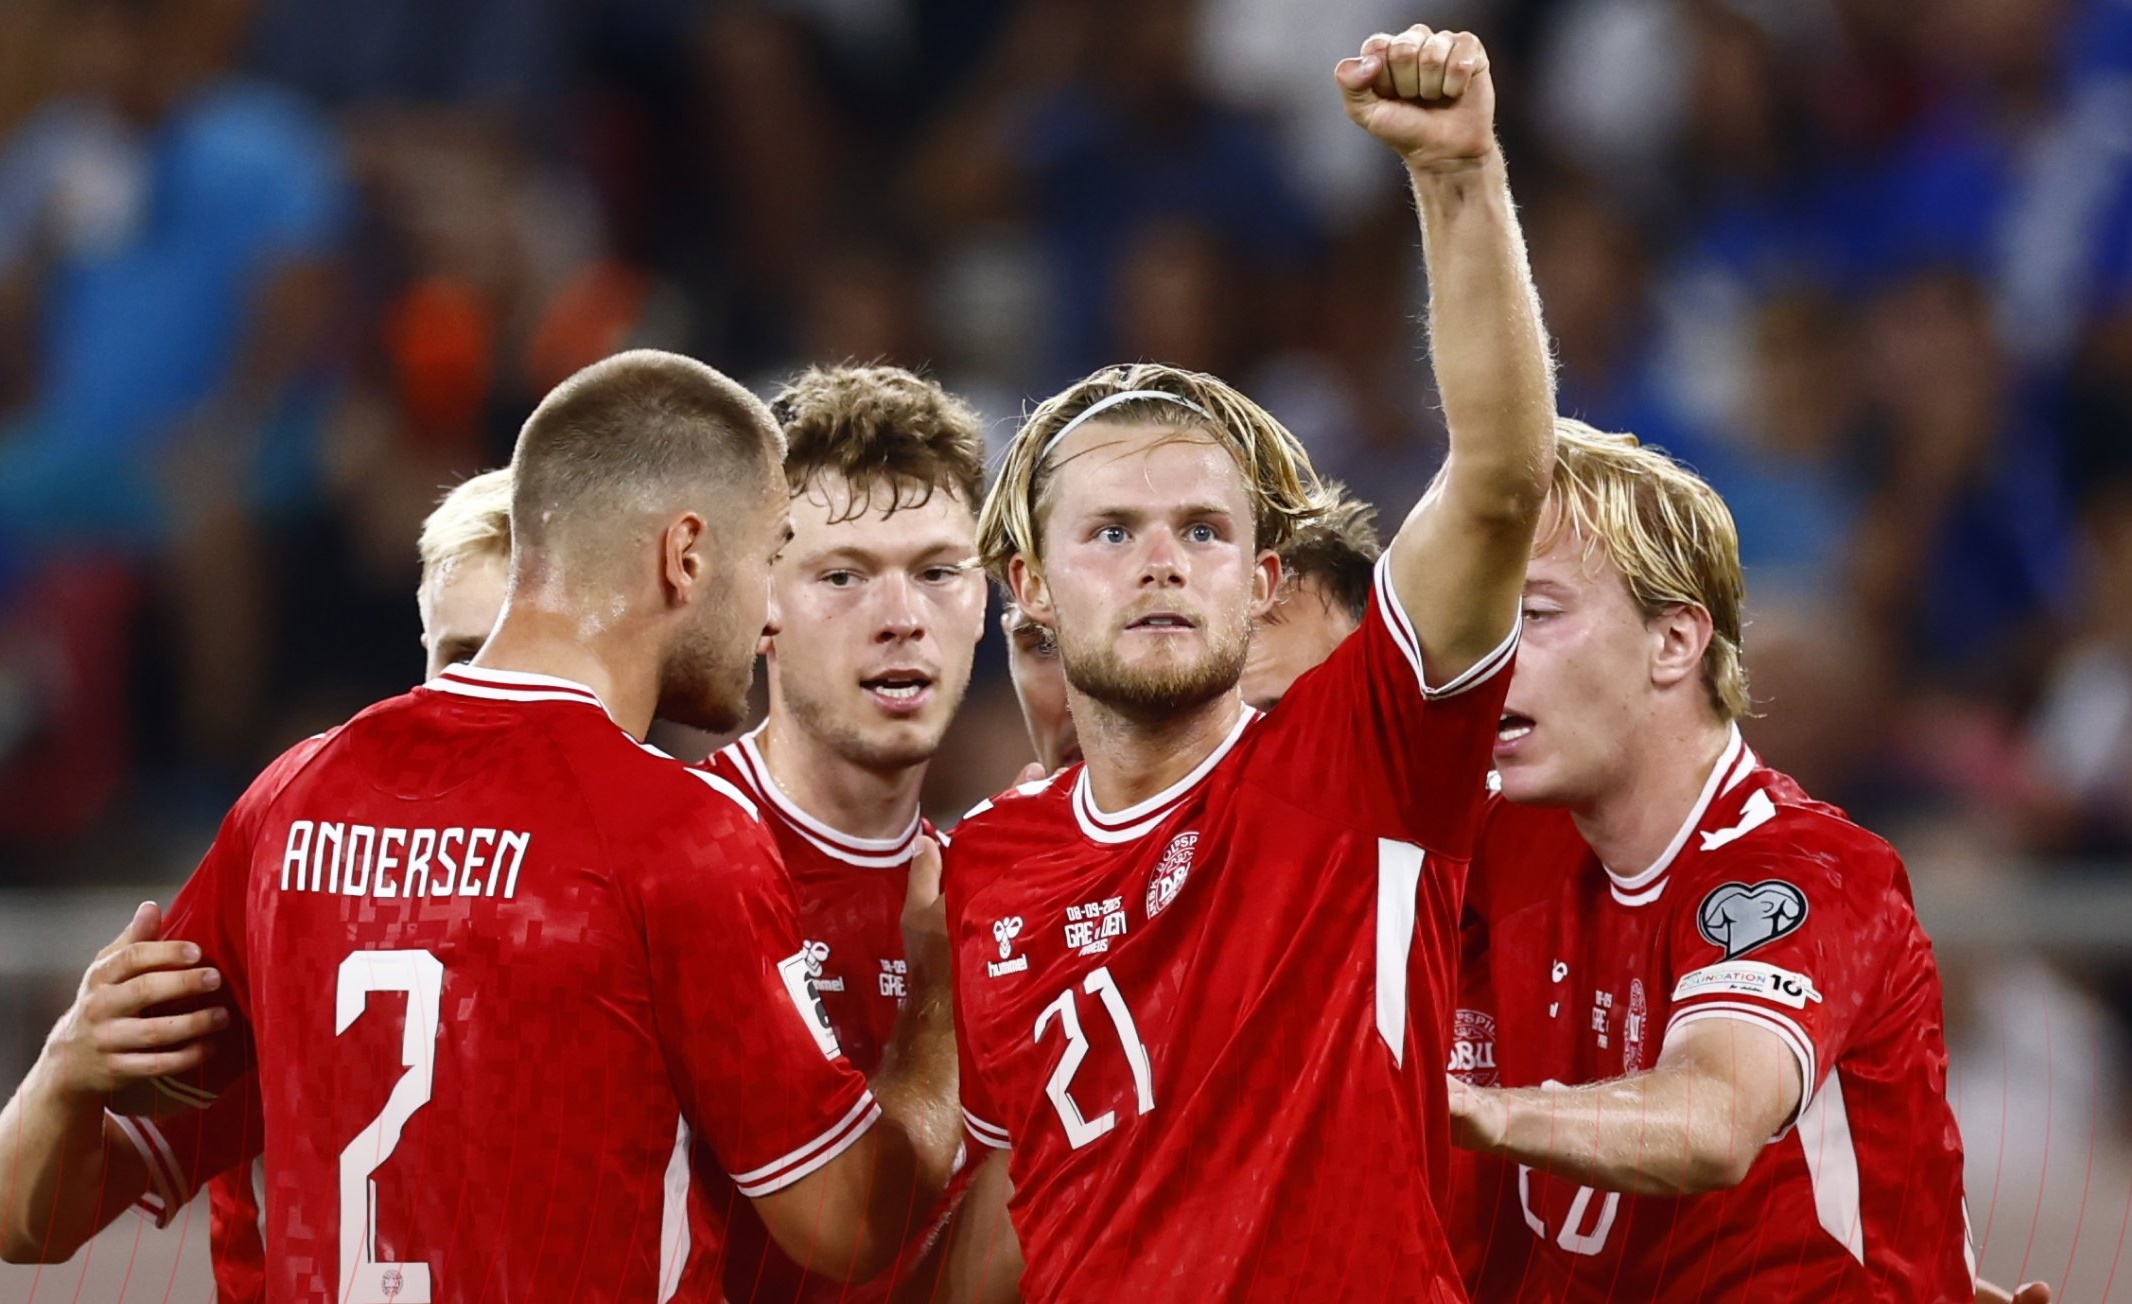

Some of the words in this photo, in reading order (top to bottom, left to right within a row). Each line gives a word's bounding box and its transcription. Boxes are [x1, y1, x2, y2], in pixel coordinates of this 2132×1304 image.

[280, 819, 531, 899] ANDERSEN
[987, 953, 1029, 978] hummel
[1064, 921, 1094, 948] GRE
[1100, 910, 1127, 938] DEN
[1033, 965, 1156, 1150] 21
[335, 948, 444, 1304] 2
